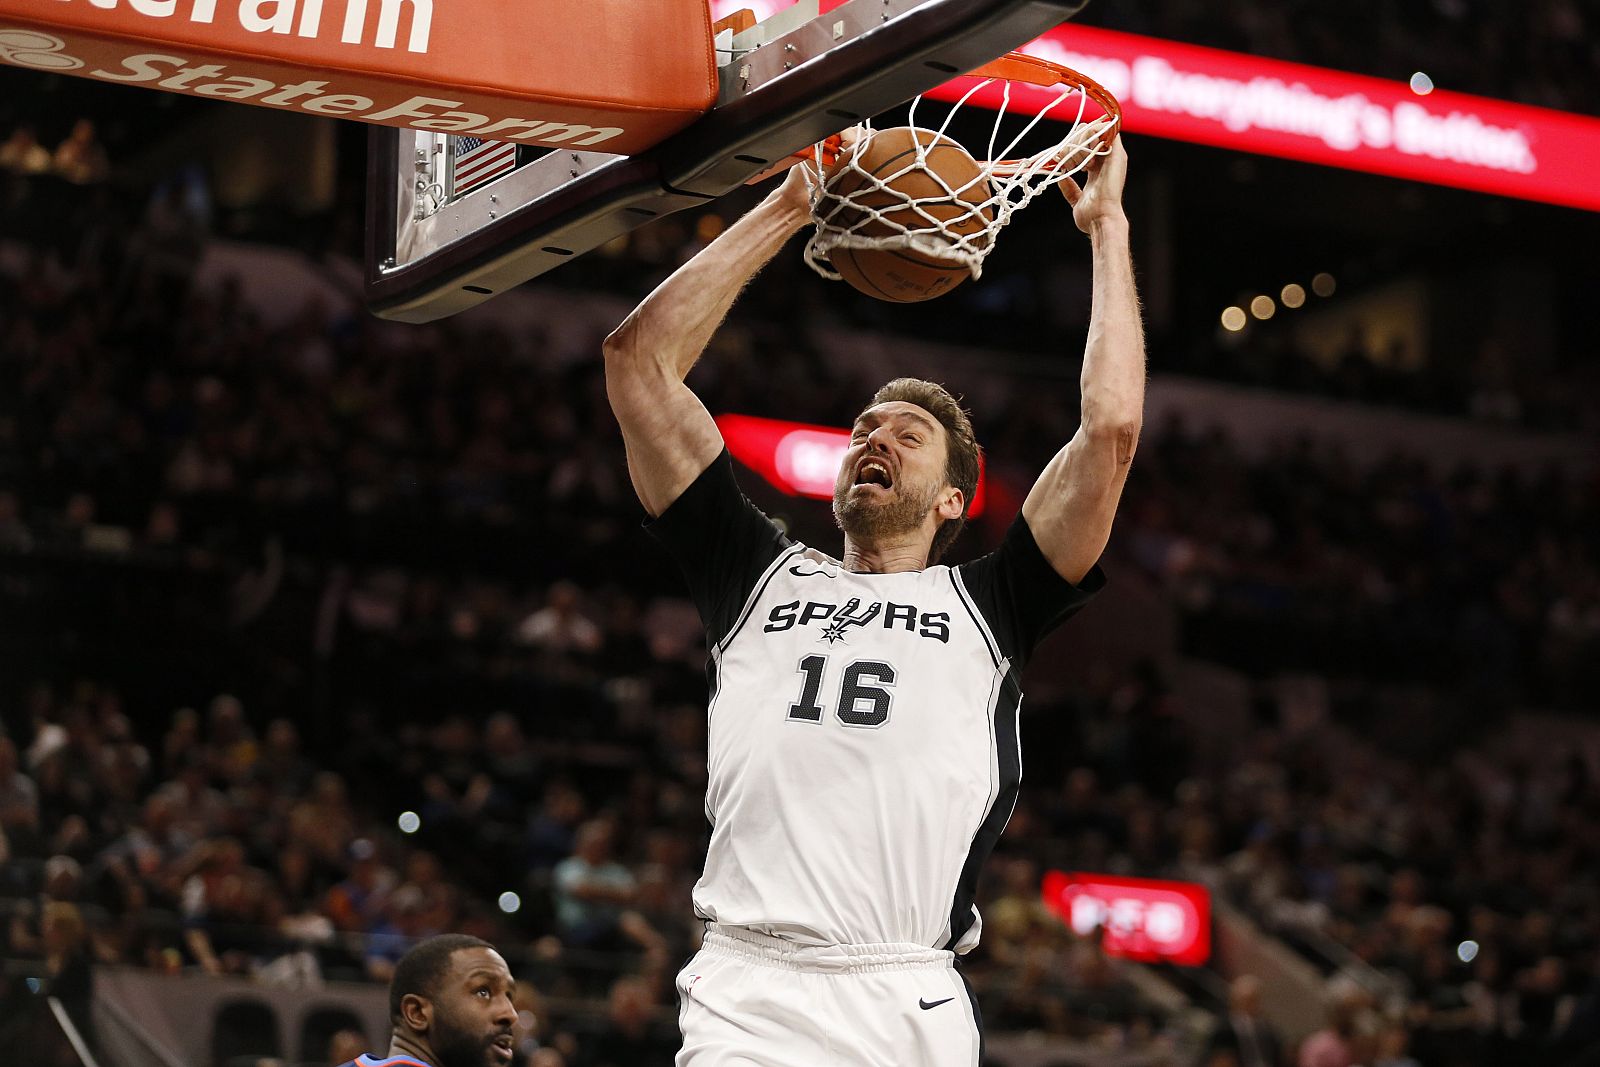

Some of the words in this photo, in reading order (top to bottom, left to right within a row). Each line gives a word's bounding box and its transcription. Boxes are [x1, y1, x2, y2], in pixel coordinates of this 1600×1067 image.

[89, 53, 374, 115] State
[357, 95, 625, 146] Farm
[763, 597, 950, 646] SPURS
[785, 652, 899, 729] 16
